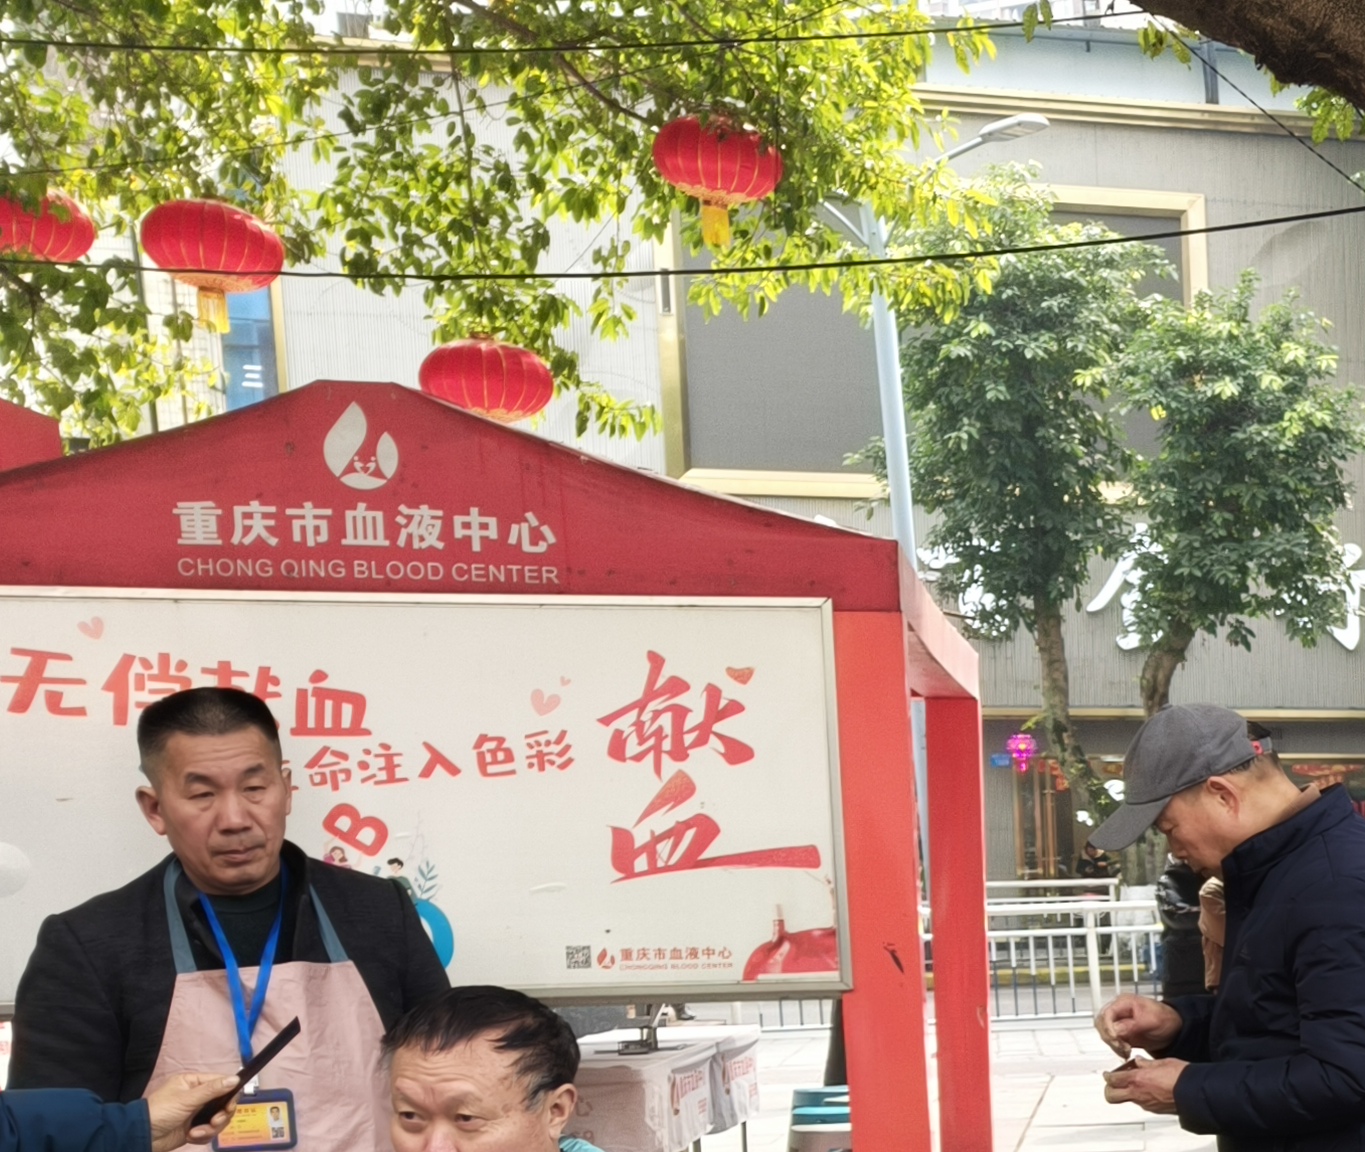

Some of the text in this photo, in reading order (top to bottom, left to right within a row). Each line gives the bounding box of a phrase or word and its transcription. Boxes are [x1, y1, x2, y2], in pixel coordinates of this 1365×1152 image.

[172, 500, 556, 553] 重庆市血液中心
[177, 557, 559, 584] CHONG QING BLOOD CENTER
[288, 729, 575, 793] 命注入色彩
[620, 946, 732, 962] 重庆市血液中心
